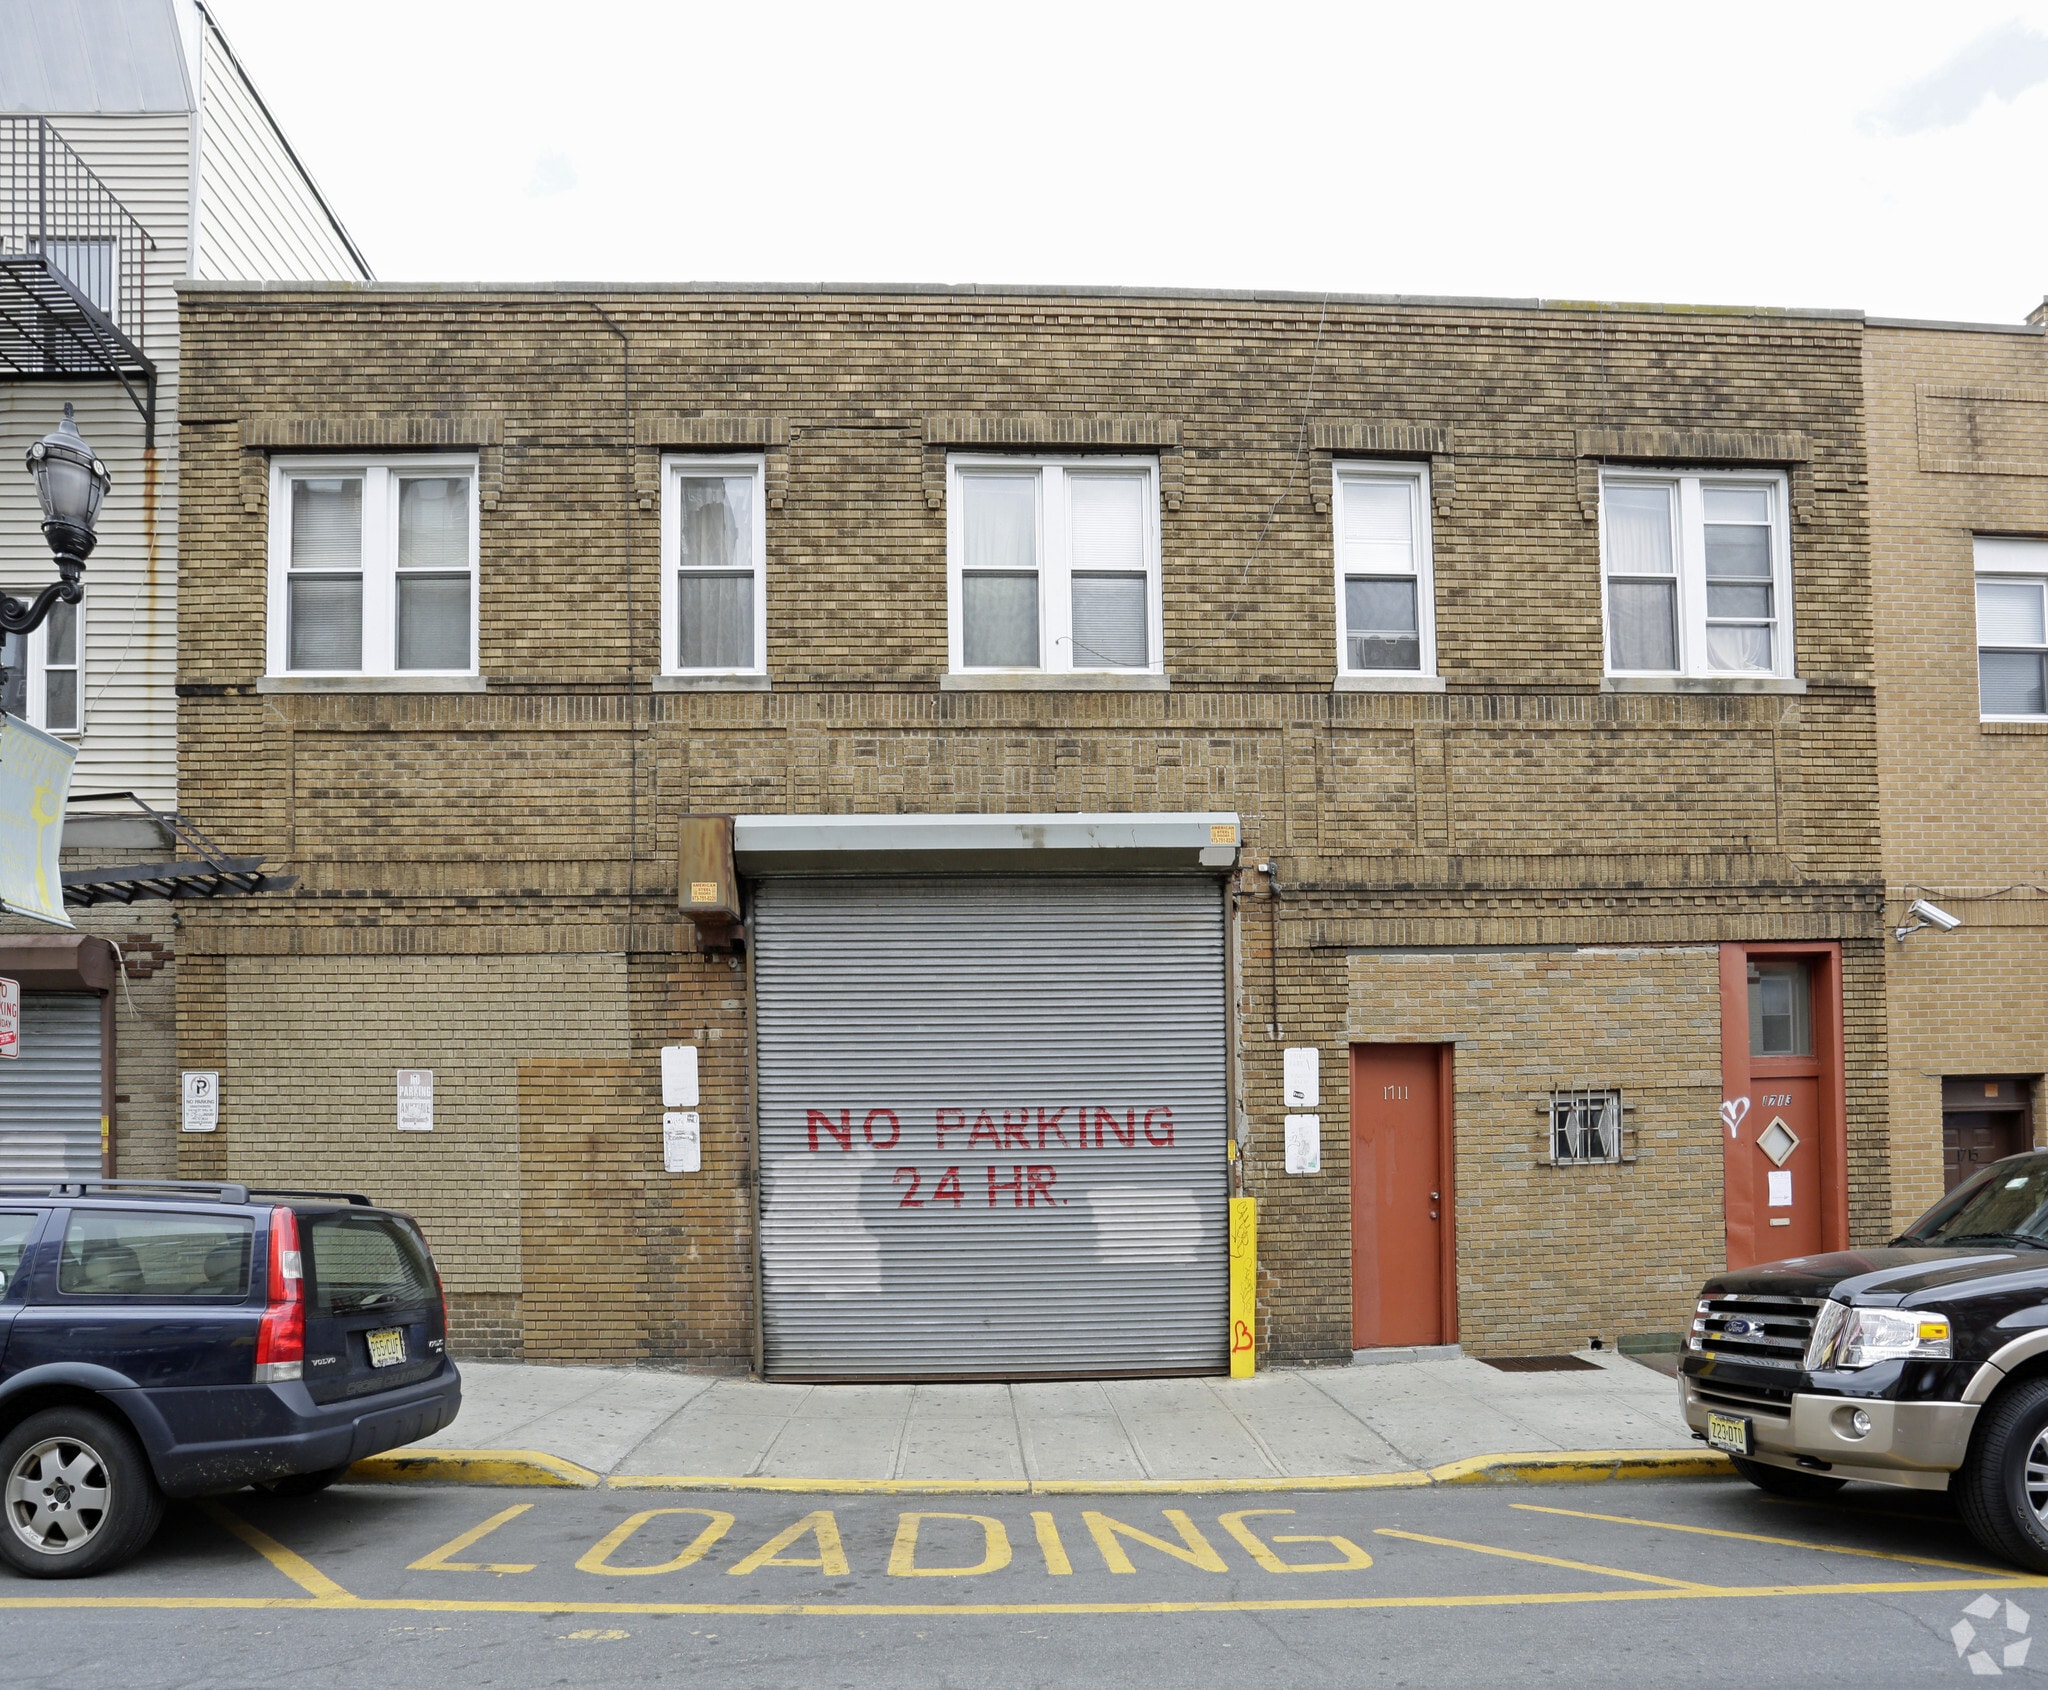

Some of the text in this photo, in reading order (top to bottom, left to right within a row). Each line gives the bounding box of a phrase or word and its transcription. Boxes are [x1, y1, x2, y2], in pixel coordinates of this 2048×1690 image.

[411, 1074, 421, 1086] NO
[400, 1086, 431, 1097] PARKING
[1383, 1085, 1409, 1100] 1711
[1761, 1094, 1793, 1107] 1713
[806, 1108, 900, 1152] NO
[936, 1106, 1175, 1151] PARKING
[892, 1165, 1068, 1208] 24 HR.
[1726, 1320, 1745, 1334] Ford
[311, 1357, 336, 1366] VOLVO
[405, 1502, 1375, 1577] LOADING
